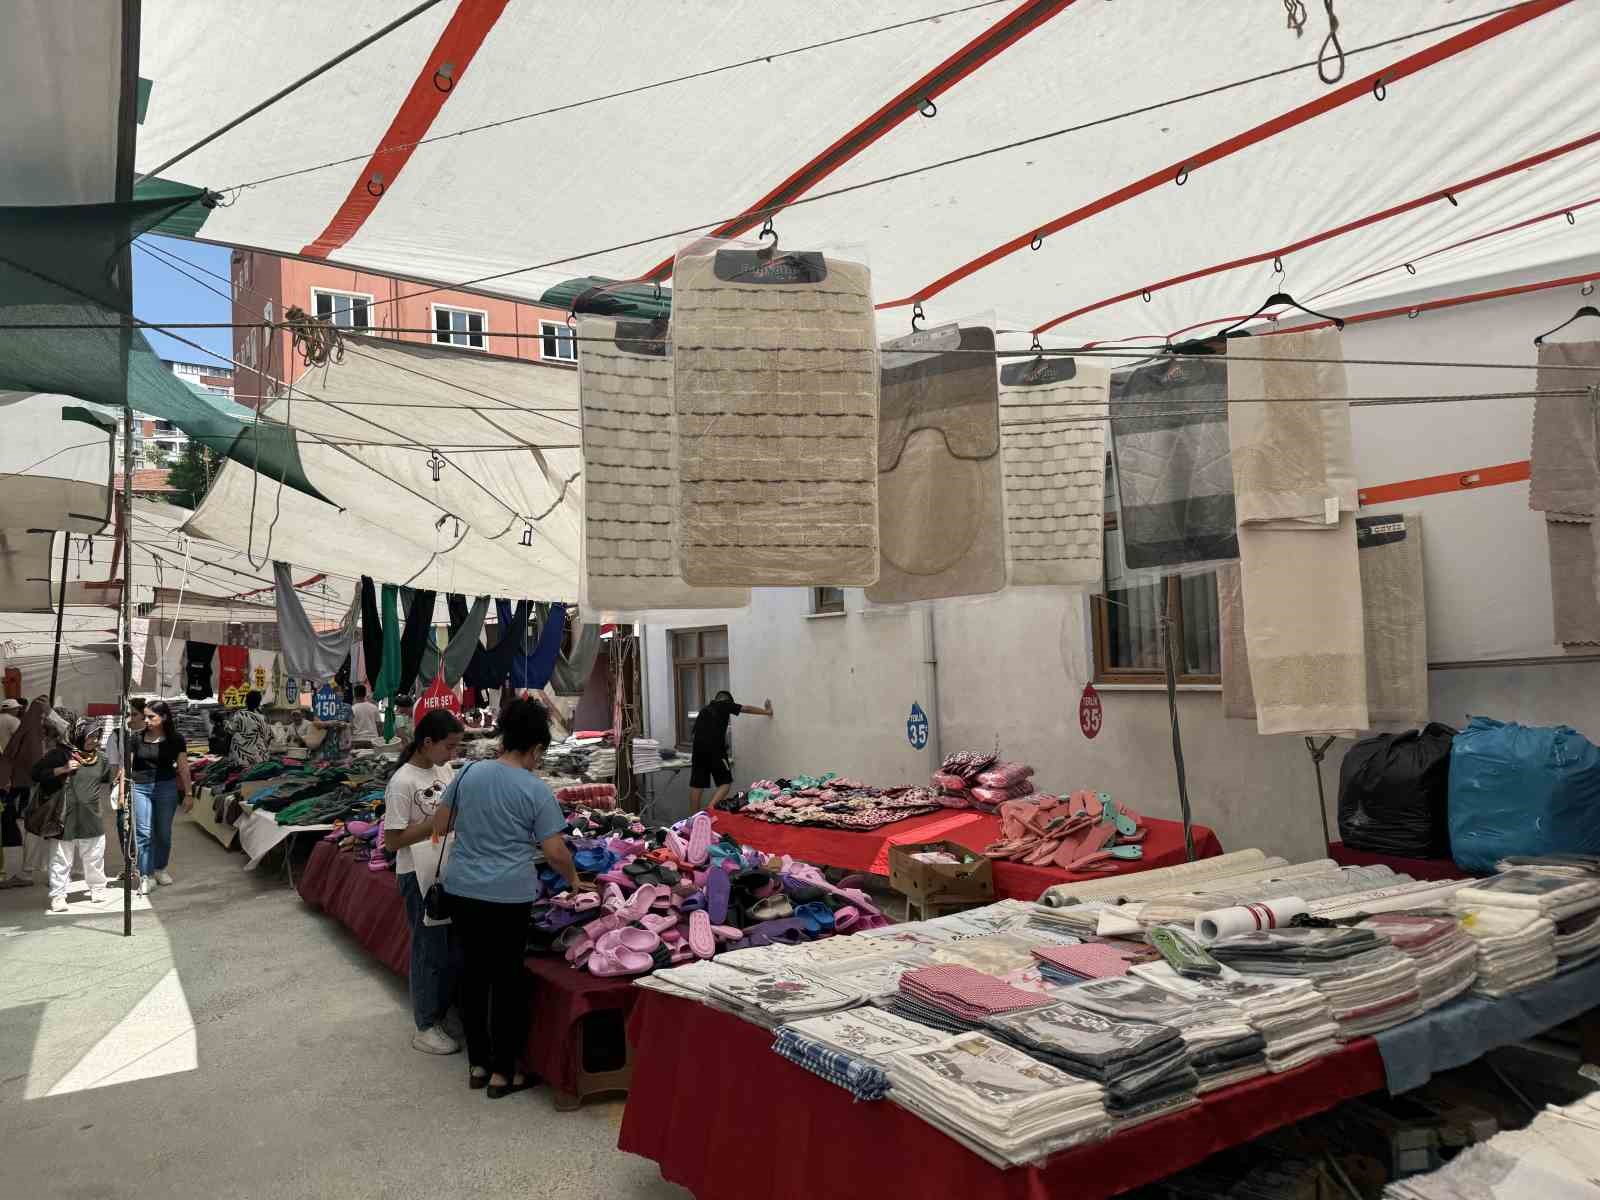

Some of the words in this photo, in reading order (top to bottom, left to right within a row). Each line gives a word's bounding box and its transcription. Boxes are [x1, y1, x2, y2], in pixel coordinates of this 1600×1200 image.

[315, 701, 336, 717] 150
[424, 697, 440, 709] HER
[1083, 708, 1100, 731] 35
[910, 724, 926, 745] 35
